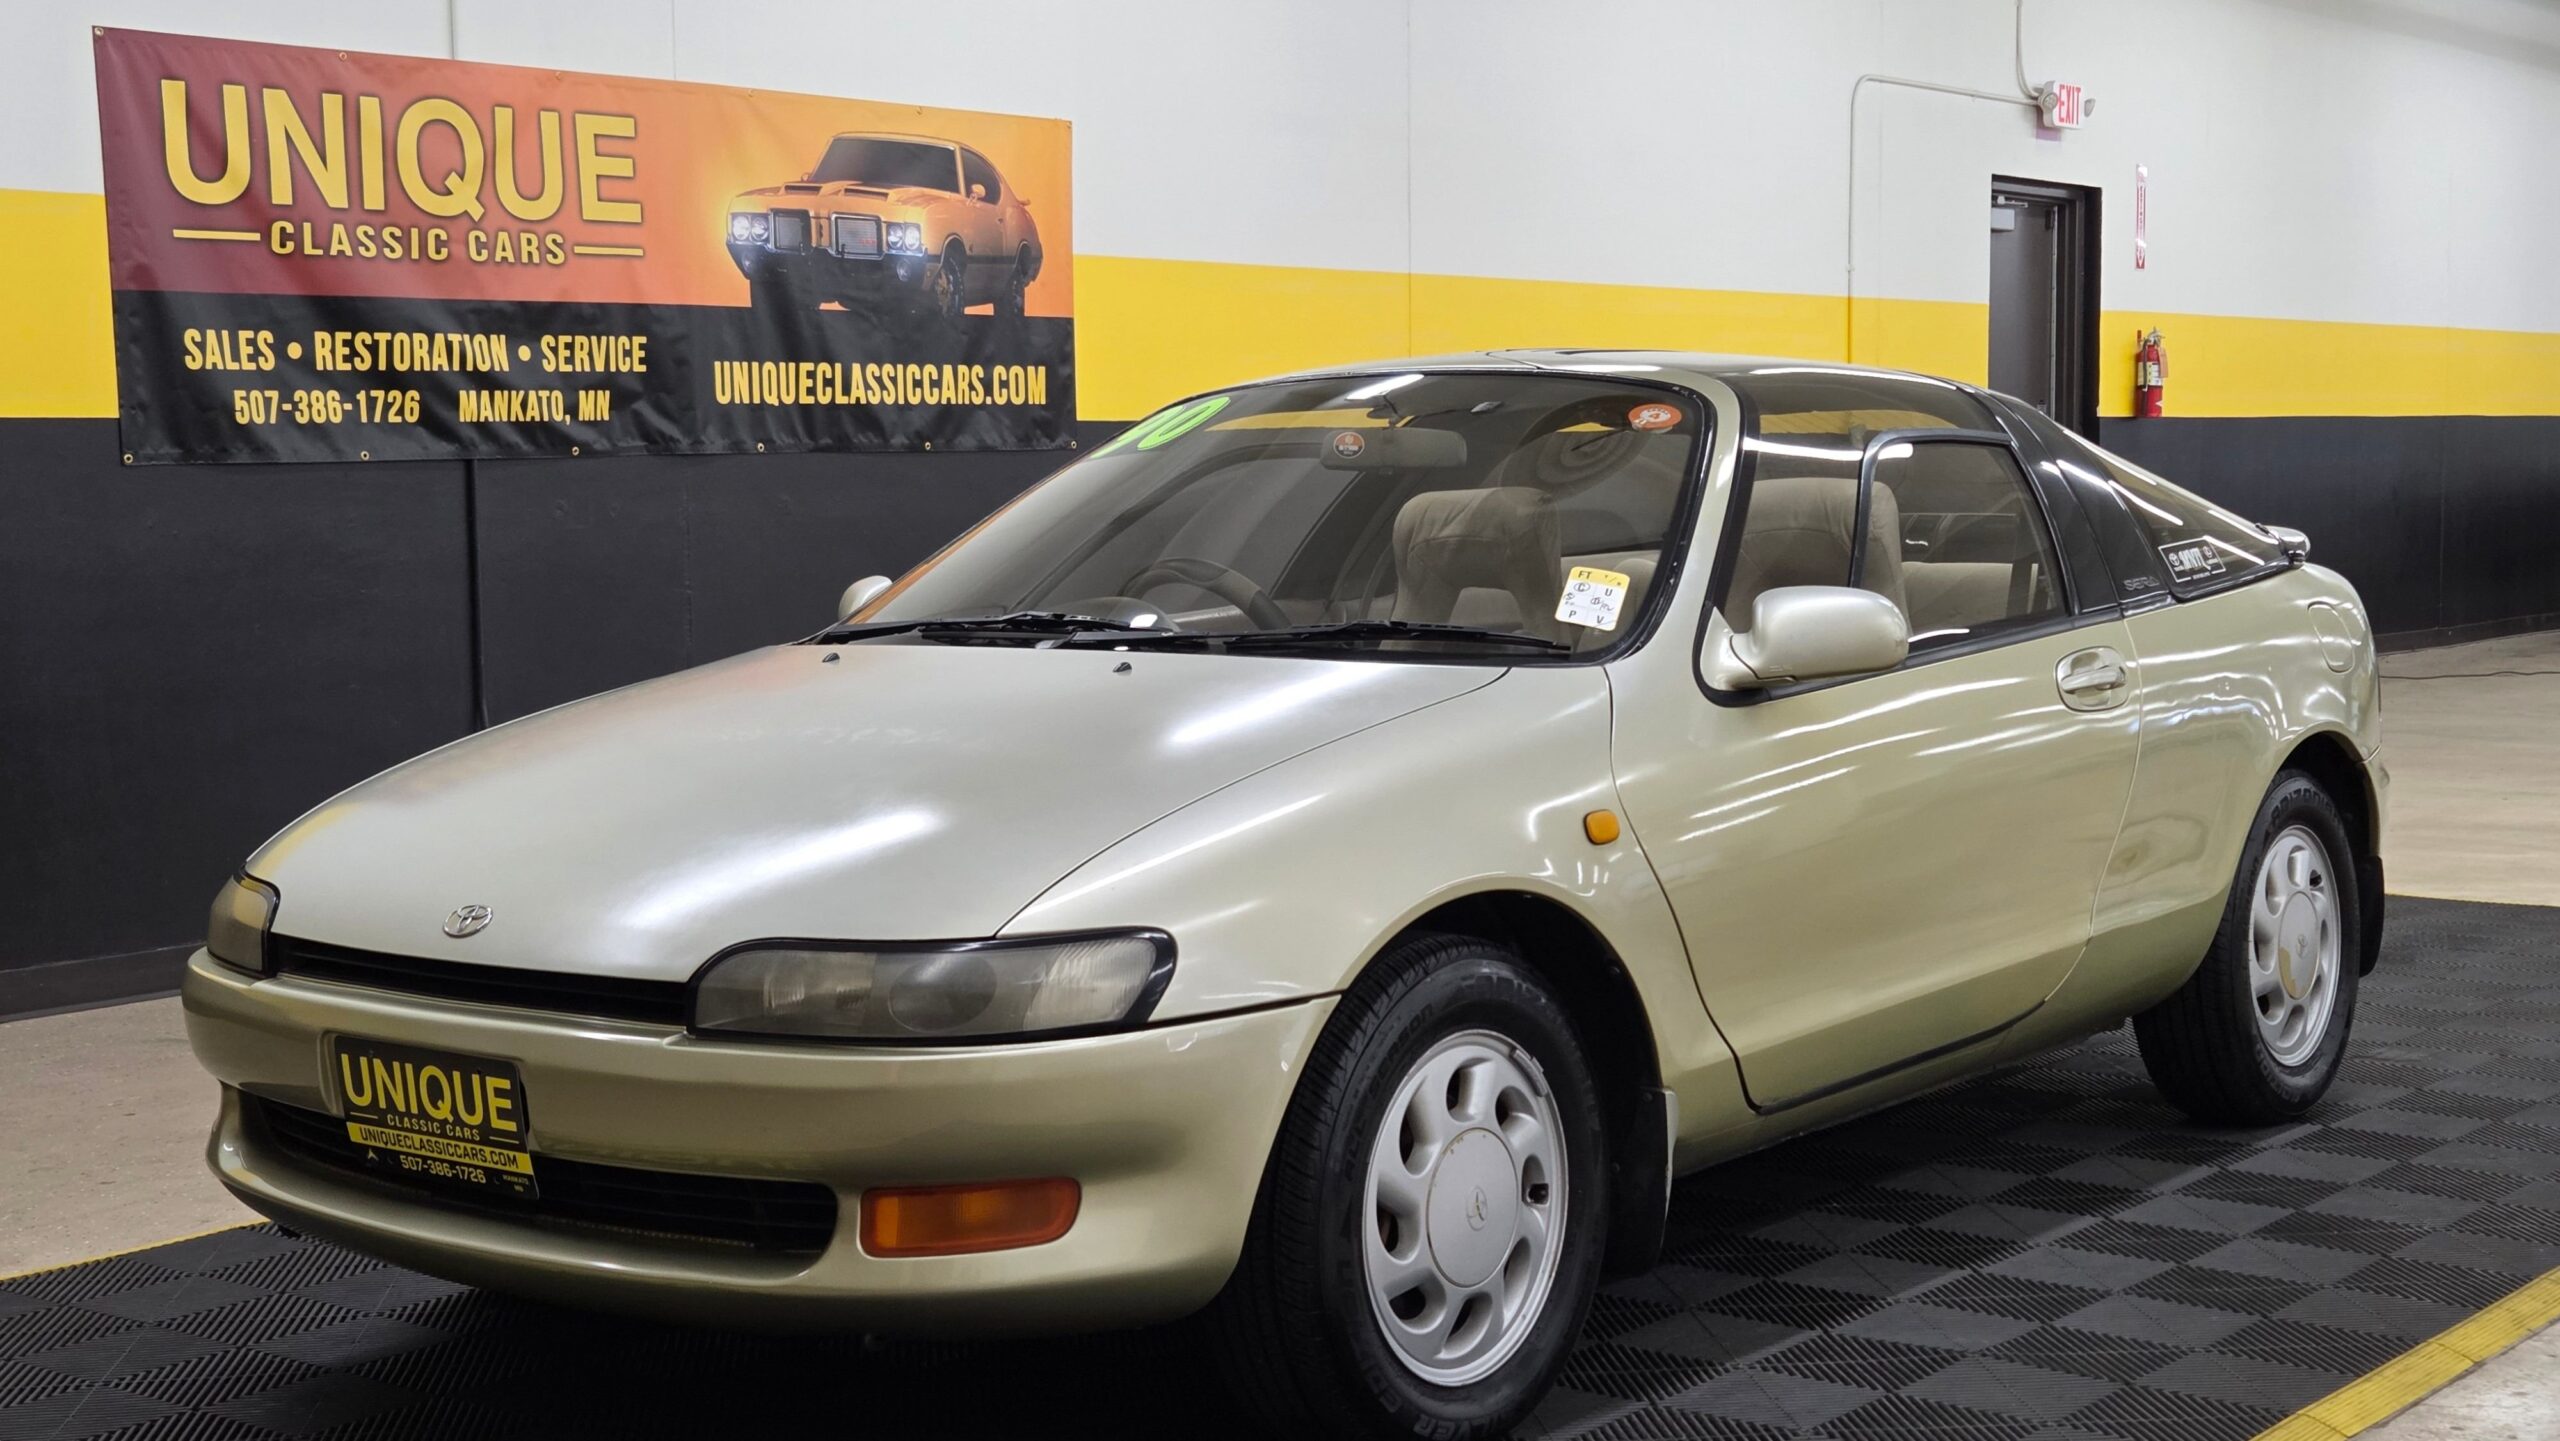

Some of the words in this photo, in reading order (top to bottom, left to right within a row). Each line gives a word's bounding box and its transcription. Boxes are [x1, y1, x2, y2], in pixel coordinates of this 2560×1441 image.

[2058, 84, 2081, 125] EXIT
[160, 79, 642, 223] UNIQUE
[270, 220, 448, 262] CLASSIC
[468, 229, 566, 265] CARS
[183, 328, 276, 371] SALES
[313, 331, 509, 372] RESTORATION
[541, 335, 648, 373] SERVICE
[714, 360, 1047, 407] UNIQUECLASSICCARS.COM
[233, 388, 420, 425] 507-386-1726
[459, 388, 571, 426] MANKATO,
[578, 390, 610, 422] MN
[340, 1052, 518, 1132] UNIQUE
[359, 1126, 519, 1170] UNIQUECLASSICCARS.COM
[386, 1113, 441, 1134] CLASSIC
[446, 1124, 481, 1142] CARS
[399, 1154, 487, 1184] 507-386-1726
